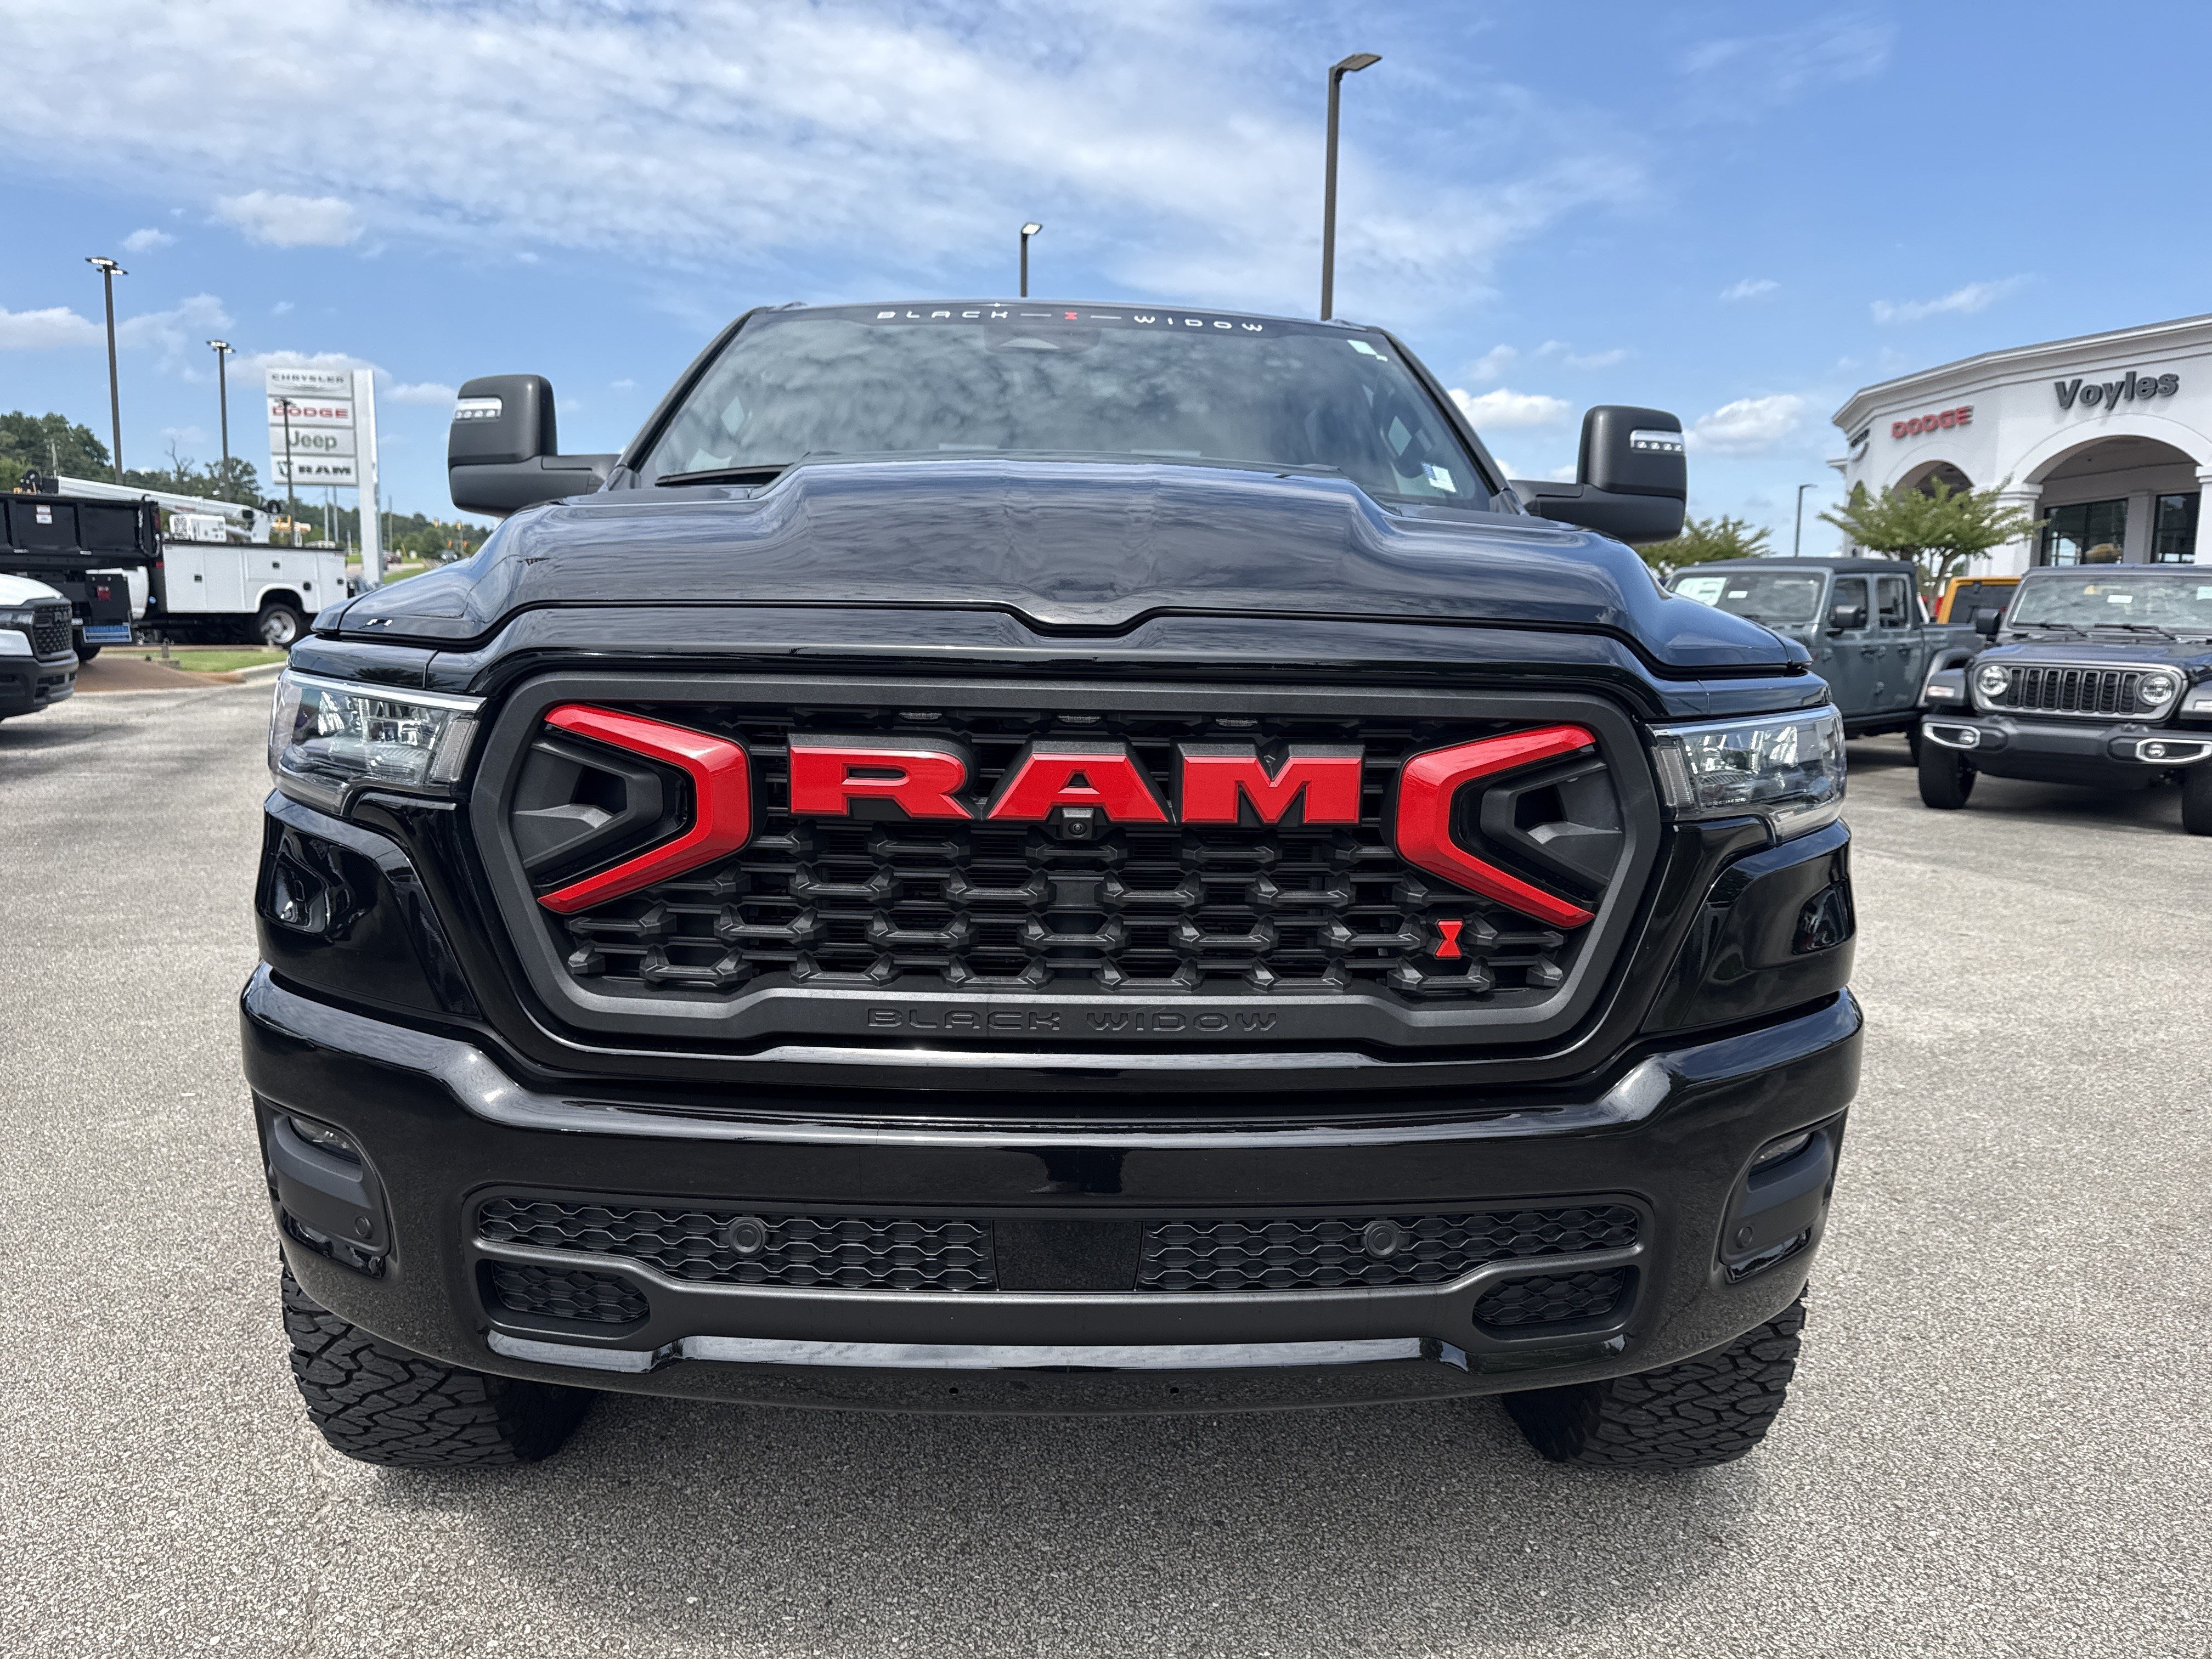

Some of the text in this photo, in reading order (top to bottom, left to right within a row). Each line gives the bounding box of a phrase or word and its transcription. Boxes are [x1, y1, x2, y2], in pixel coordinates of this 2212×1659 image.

[877, 311, 1263, 331] BLACK WIDOW
[272, 374, 344, 383] CHRYSLER
[2055, 371, 2180, 410] Voyles
[273, 407, 348, 418] DODGE
[1892, 405, 1974, 439] DODGE
[289, 430, 337, 451] Jeep
[298, 465, 351, 475] RAM
[788, 733, 1365, 826] RAM
[867, 1008, 1277, 1032] BLACK WIDOW
